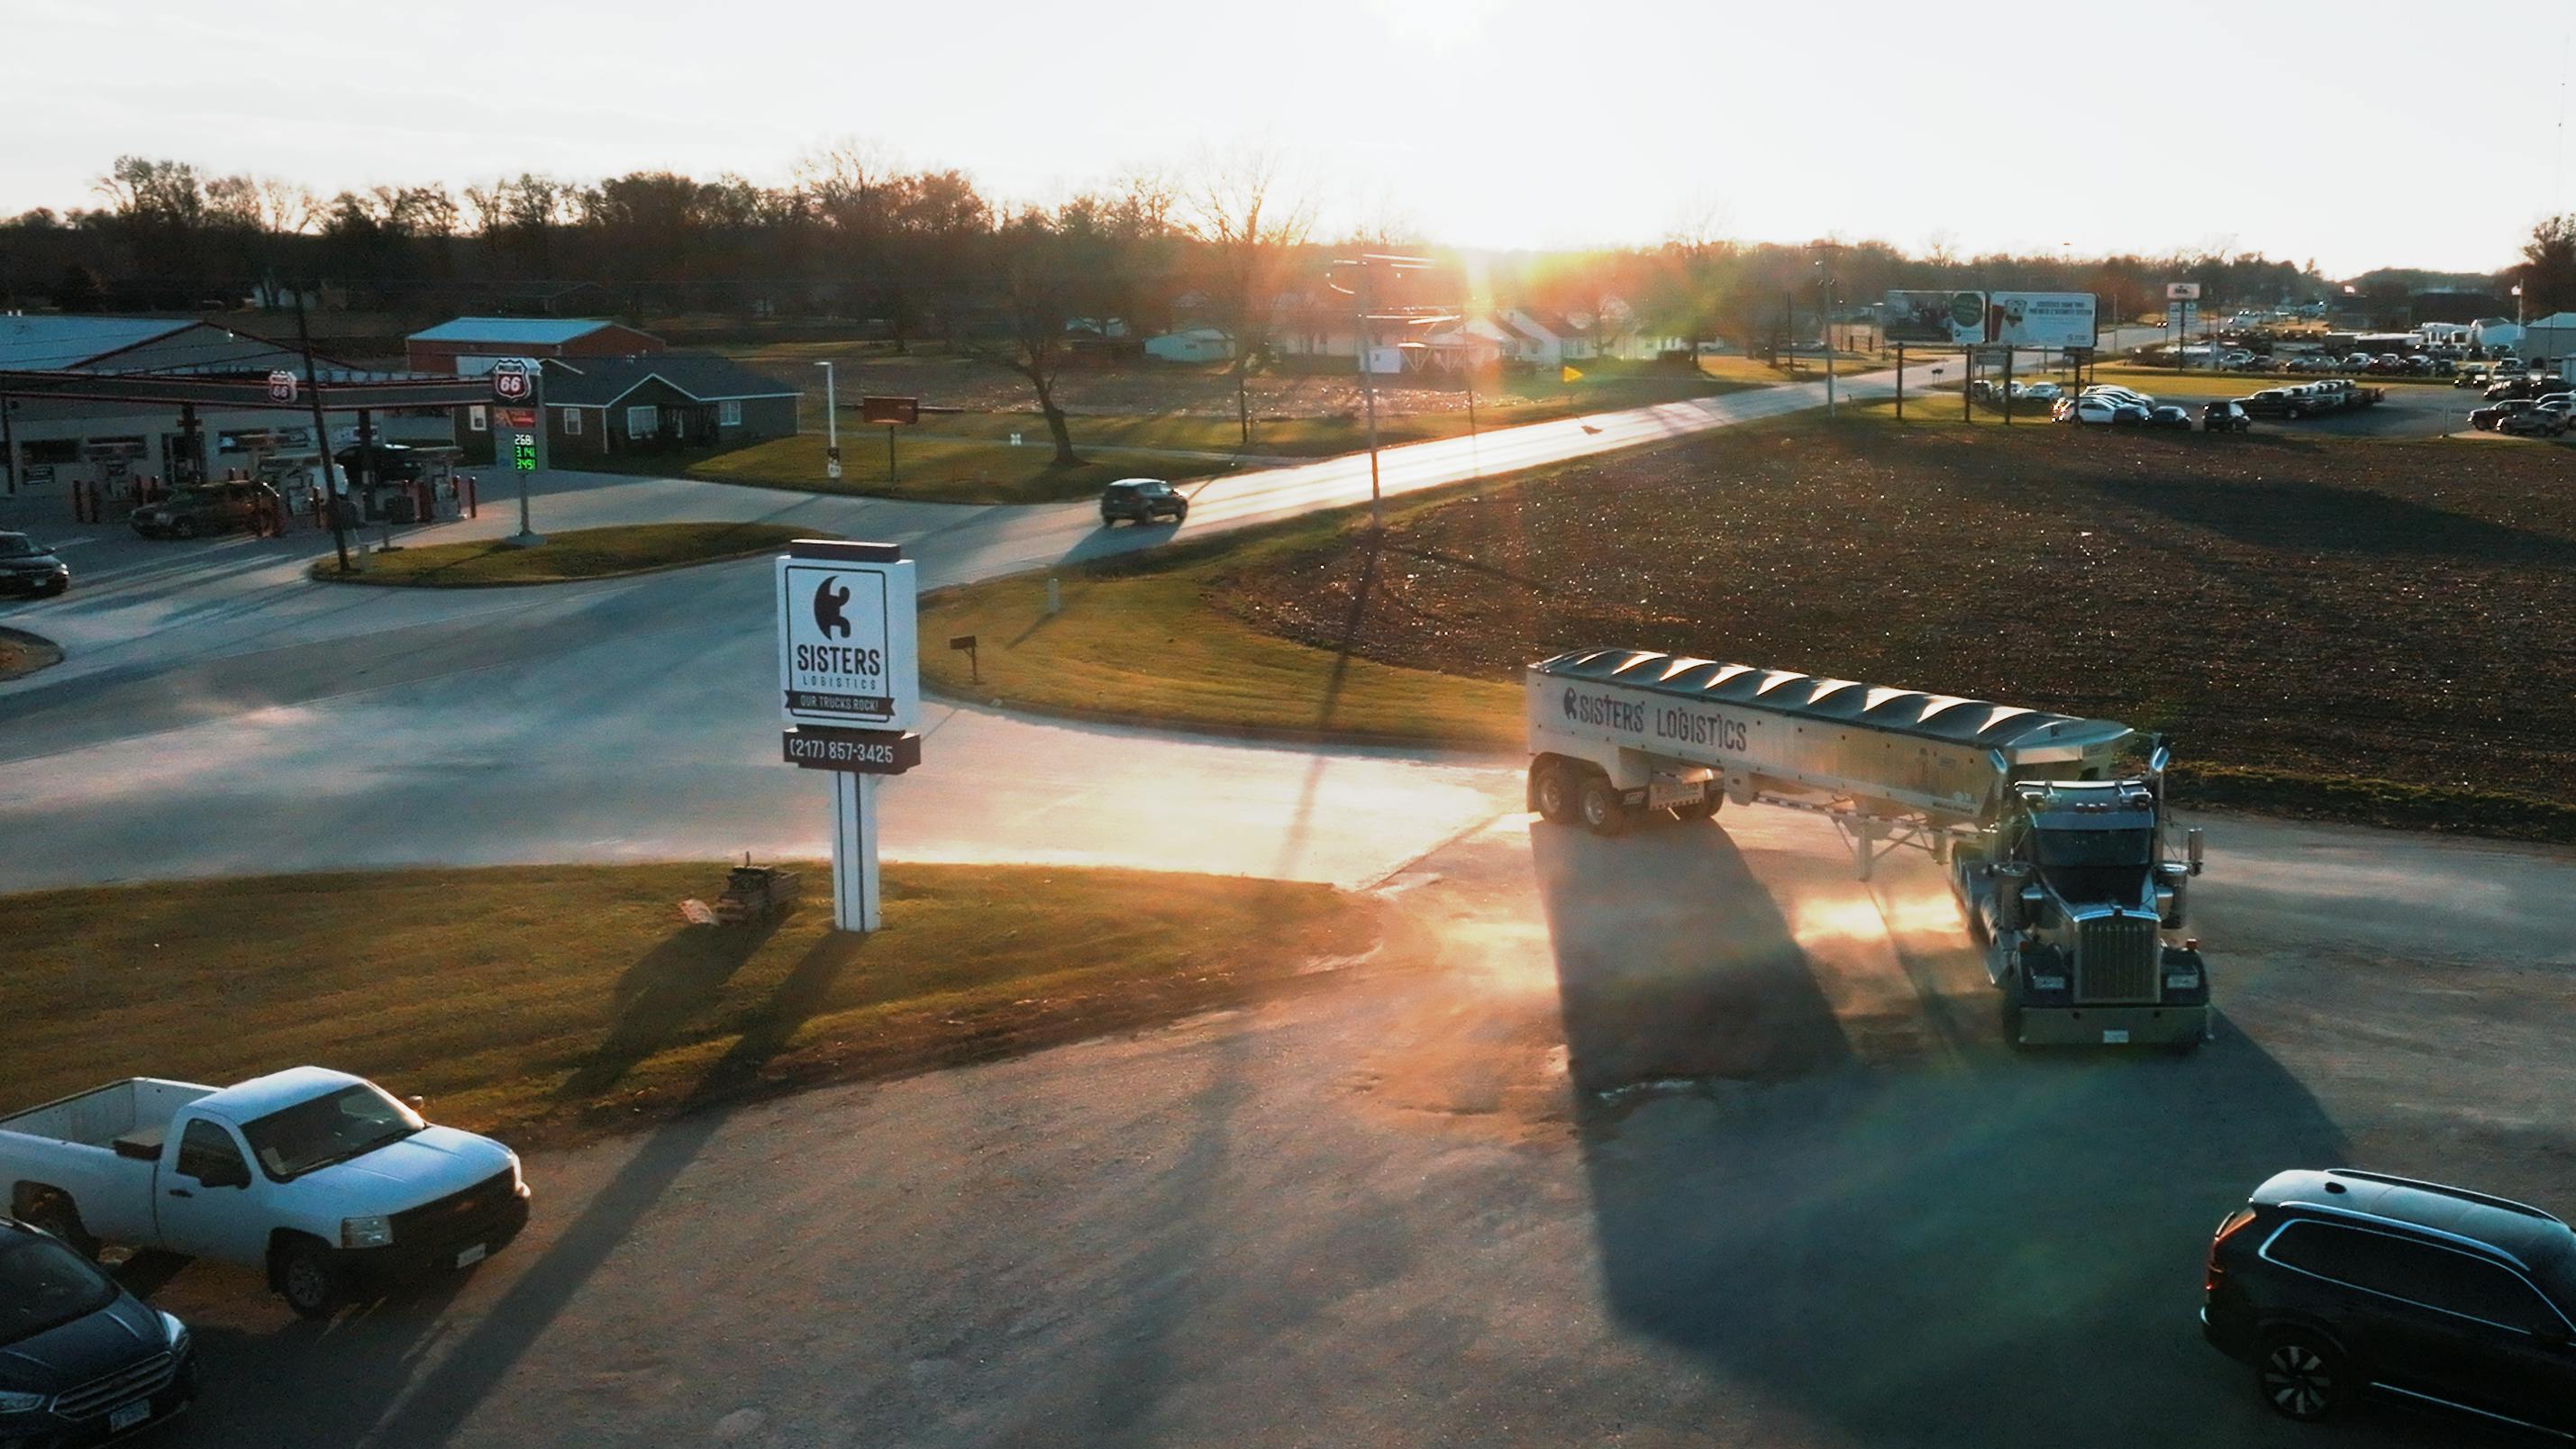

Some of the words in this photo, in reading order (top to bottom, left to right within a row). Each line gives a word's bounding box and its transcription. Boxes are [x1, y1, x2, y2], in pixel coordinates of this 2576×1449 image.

[500, 376, 522, 392] 66
[797, 644, 880, 676] SISTERS
[803, 676, 877, 689] LOGISTICS
[800, 694, 818, 707] OUR
[819, 696, 851, 709] TRUCKS
[852, 697, 879, 711] ROCK!
[1579, 694, 1644, 733] SISTERS
[1656, 707, 1747, 752] LOGISTICS
[789, 738, 824, 758] (217)
[828, 743, 893, 763] 857-3425
